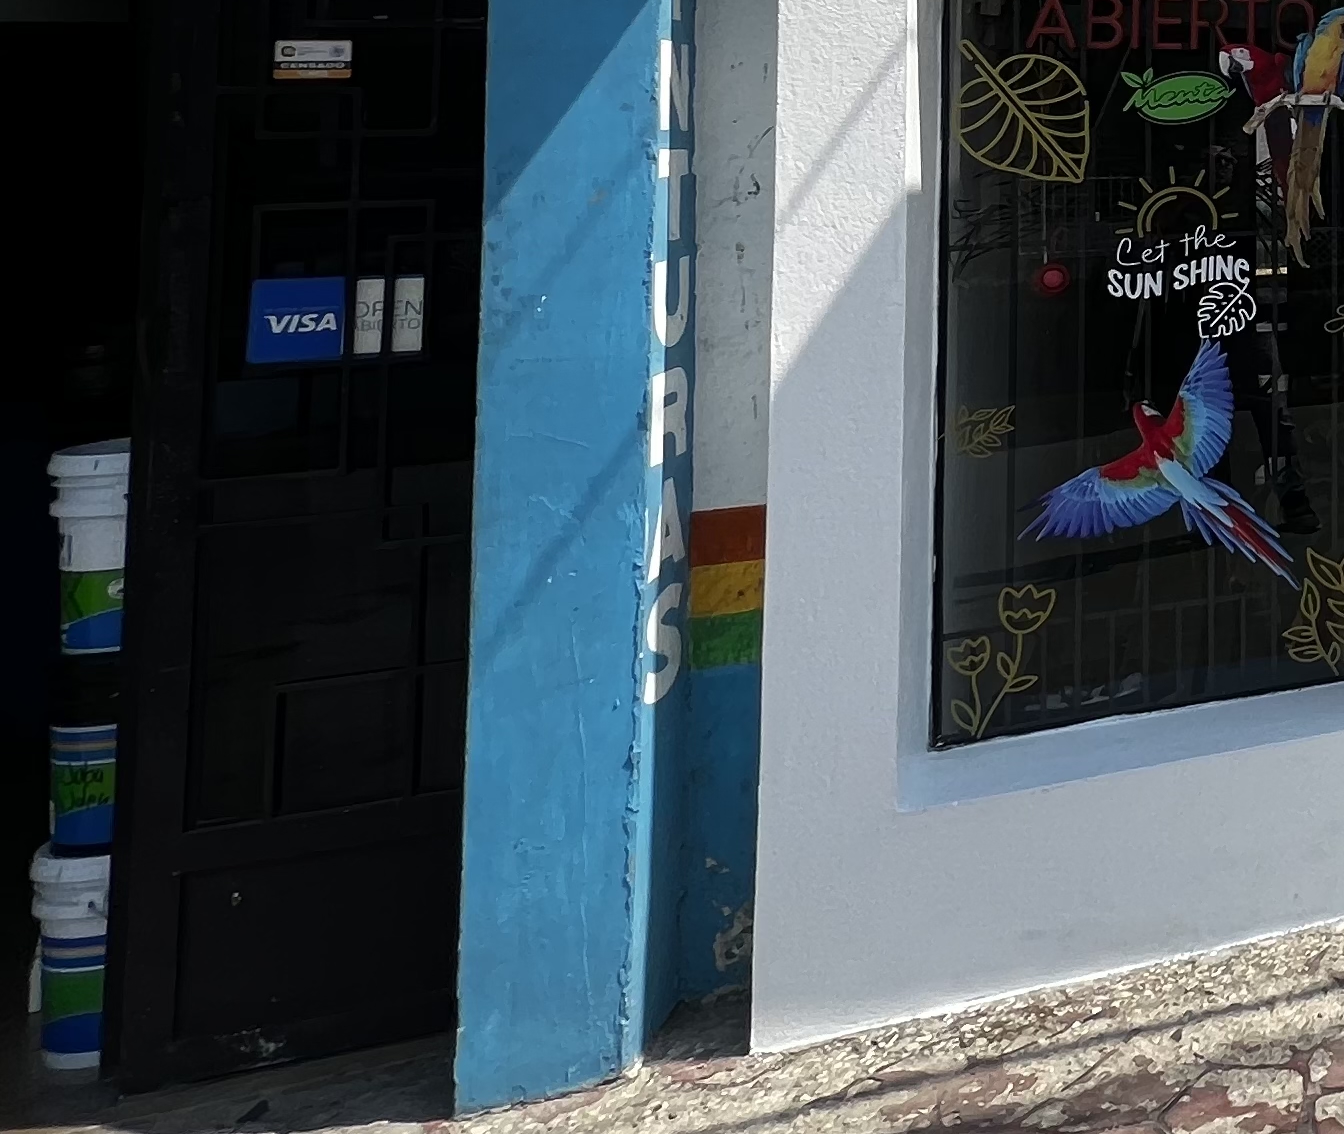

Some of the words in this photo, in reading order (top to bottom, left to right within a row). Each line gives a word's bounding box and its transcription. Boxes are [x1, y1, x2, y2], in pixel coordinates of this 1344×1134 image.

[1123, 80, 1236, 112] Menta
[1179, 224, 1237, 257] the
[1107, 268, 1163, 300] SUN
[264, 312, 338, 334] VISA
